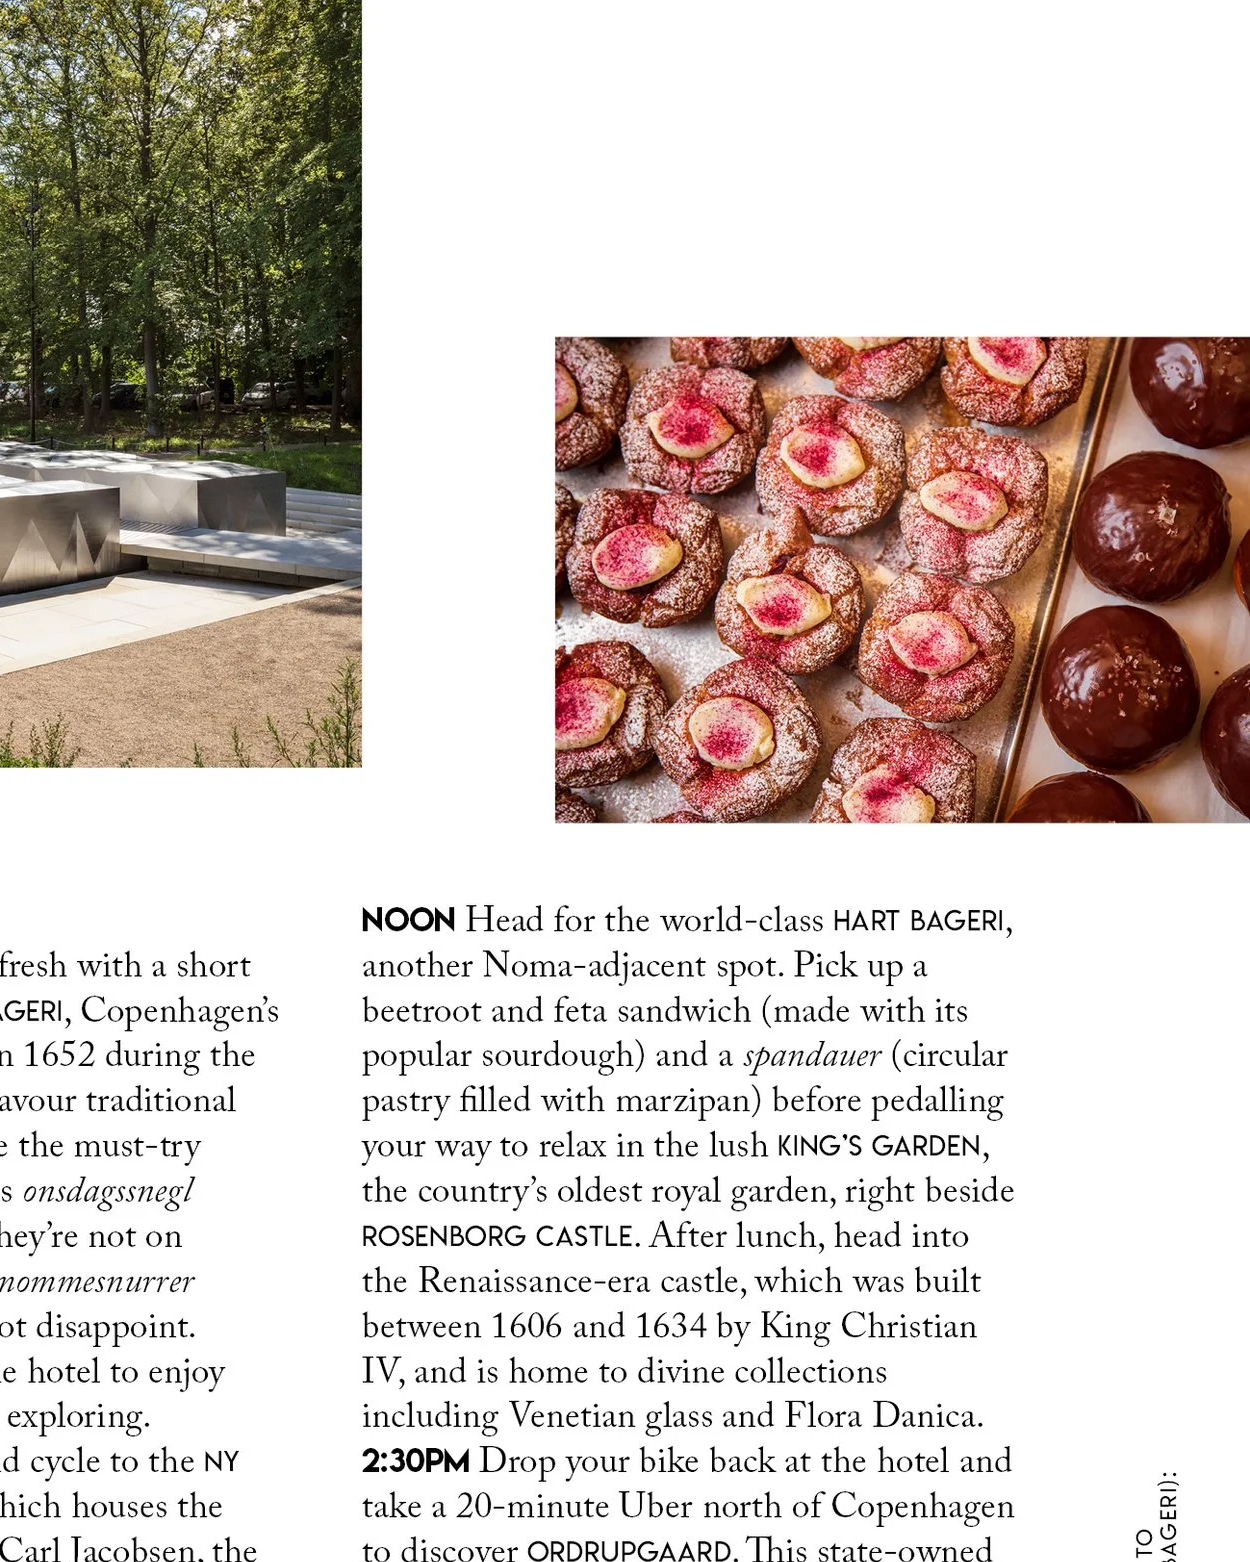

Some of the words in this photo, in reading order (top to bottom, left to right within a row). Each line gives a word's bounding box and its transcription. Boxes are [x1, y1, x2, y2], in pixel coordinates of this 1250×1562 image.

[363, 907, 454, 931] NOON
[466, 905, 543, 931] Head
[554, 905, 595, 932] for
[605, 906, 649, 931] the
[660, 905, 823, 931] world-class
[835, 910, 900, 930] HART
[912, 910, 1012, 938] BAGERI,
[77, 951, 142, 977] with
[152, 961, 166, 977] a
[178, 951, 251, 977] short
[82, 996, 278, 1032] Copenhagen’s
[363, 1312, 481, 1338] between
[493, 1312, 561, 1338] 1606
[574, 1311, 625, 1338] and
[638, 1312, 707, 1338] 1634
[717, 1312, 751, 1347] by
[761, 1311, 831, 1347] King
[842, 1311, 977, 1338] Christian
[362, 1544, 390, 1562] to
[401, 1536, 518, 1562] discover
[528, 1541, 738, 1562] ORDRUPGAARD.
[746, 1536, 806, 1562] This
[819, 1536, 992, 1562] state-owned
[1136, 1530, 1152, 1558] TO
